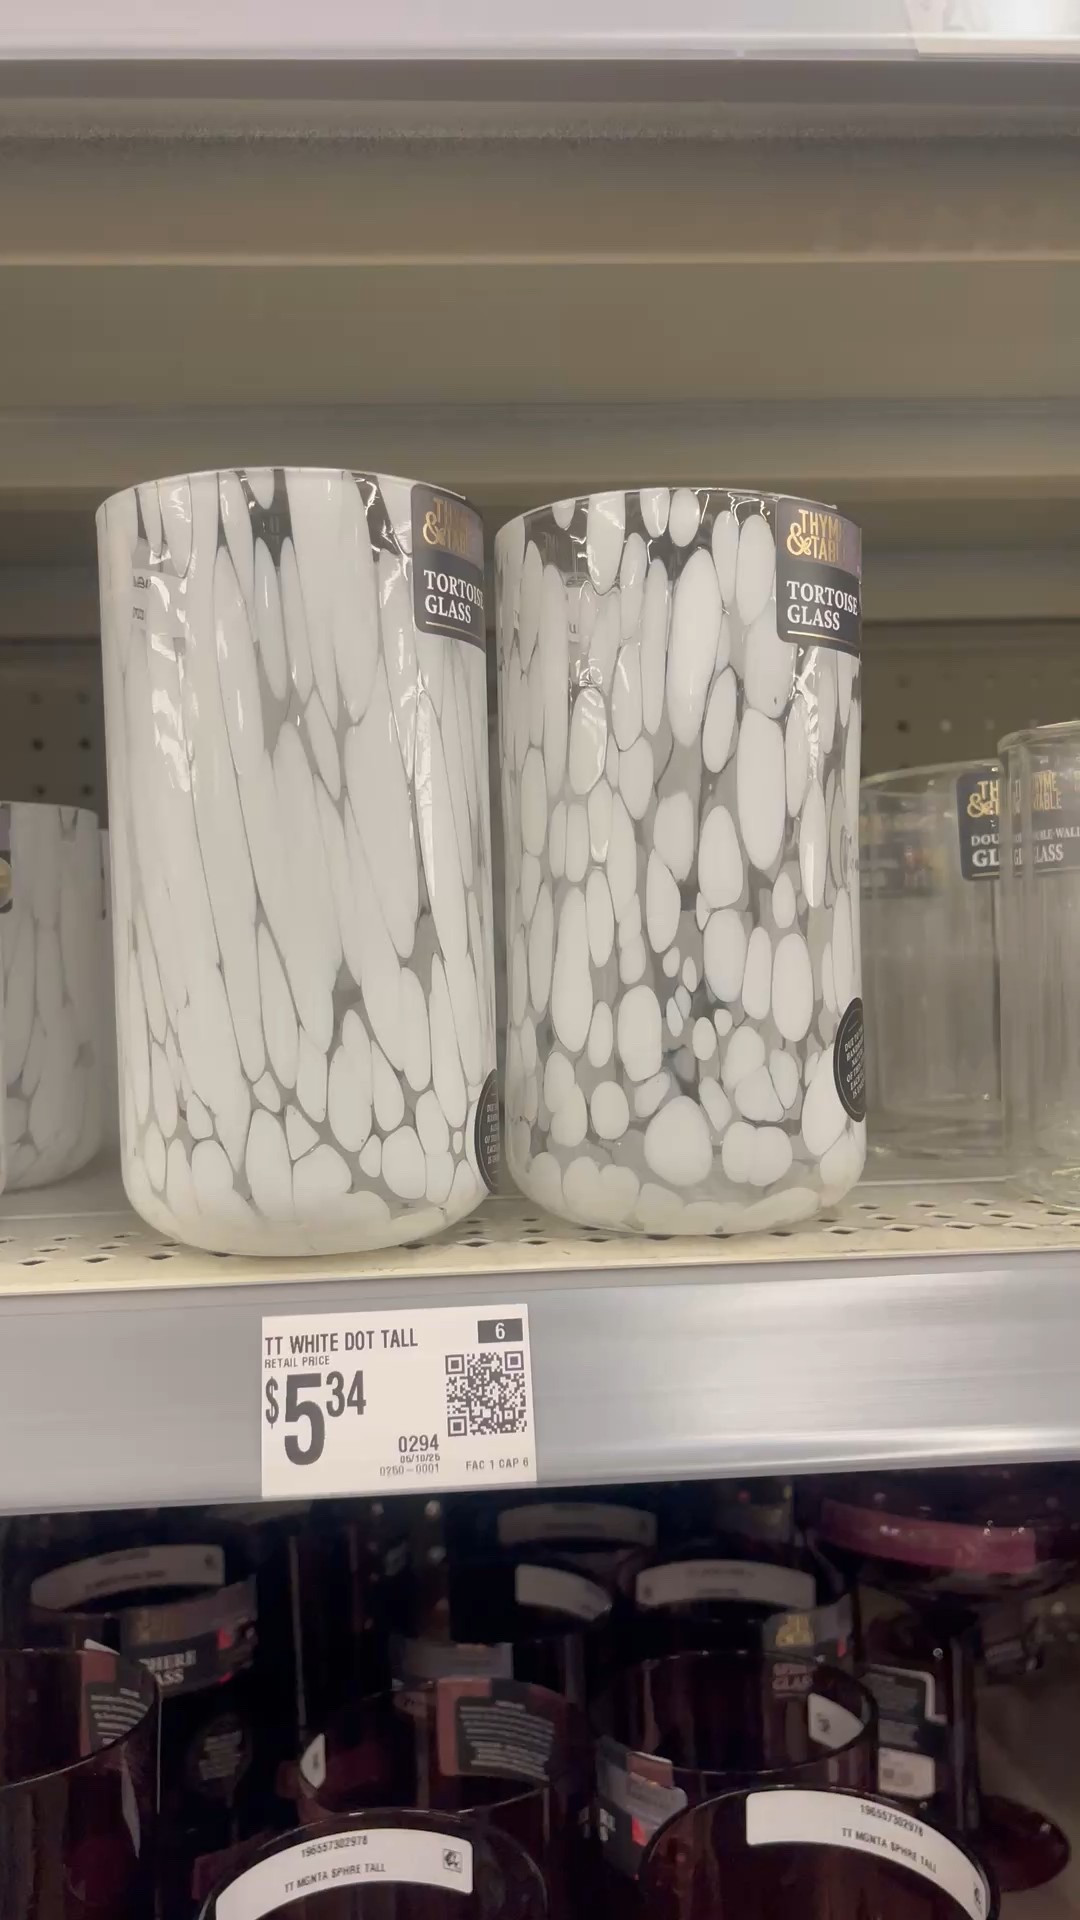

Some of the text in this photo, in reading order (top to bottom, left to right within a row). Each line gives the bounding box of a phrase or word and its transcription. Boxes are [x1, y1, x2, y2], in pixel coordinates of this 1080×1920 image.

[424, 569, 484, 610] TORTOISE
[786, 580, 858, 616] TORTOISE
[425, 594, 471, 624] GLASS
[787, 604, 840, 631] GLASS
[265, 1328, 418, 1355] TT WHITE DOT TALL
[495, 1322, 505, 1339] 6
[264, 1355, 330, 1369] RETAIL PRICE
[398, 1434, 439, 1453] 0294
[466, 1460, 485, 1471] FAC
[490, 1460, 494, 1470] 1
[499, 1458, 518, 1468] CAP
[842, 1828, 852, 1838] TT
[284, 1863, 386, 1893] TT MGNTA SPHRE TALL
